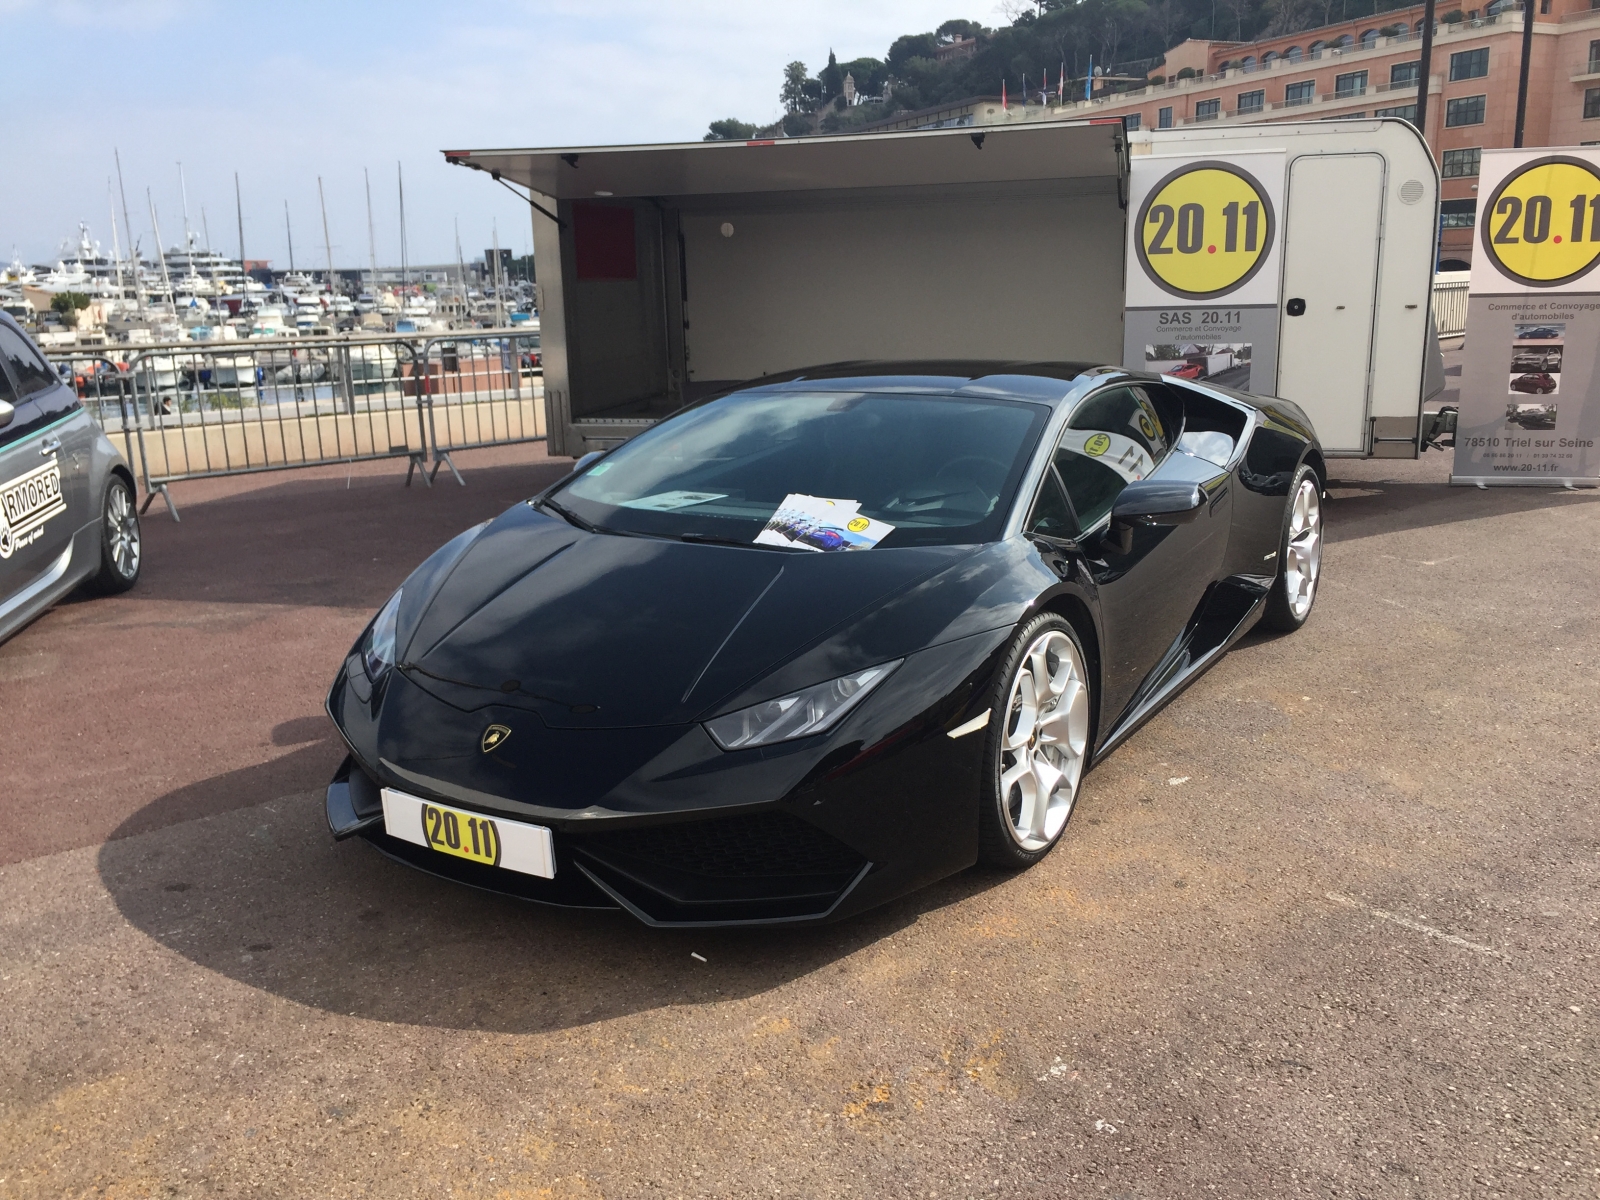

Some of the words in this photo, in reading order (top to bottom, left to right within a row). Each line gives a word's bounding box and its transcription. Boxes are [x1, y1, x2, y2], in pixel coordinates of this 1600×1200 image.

[1493, 194, 1600, 244] 20.11
[1147, 201, 1259, 255] 20.11
[1488, 303, 1536, 311] Commerce
[1549, 302, 1600, 312] Convoyage
[1159, 311, 1192, 325] SAS
[1201, 310, 1241, 324] 20.11
[1511, 312, 1575, 321] d'automobiles
[1156, 325, 1193, 333] Commerce
[1203, 324, 1242, 333] Convoyage
[1174, 333, 1222, 341] d'automobiles
[1464, 437, 1499, 447] 78510
[1504, 437, 1531, 448] Triel
[1534, 439, 1555, 448] sur
[1558, 437, 1594, 448] Seine
[1493, 463, 1559, 472] www.20-11.fr
[427, 807, 493, 859] 20.11
